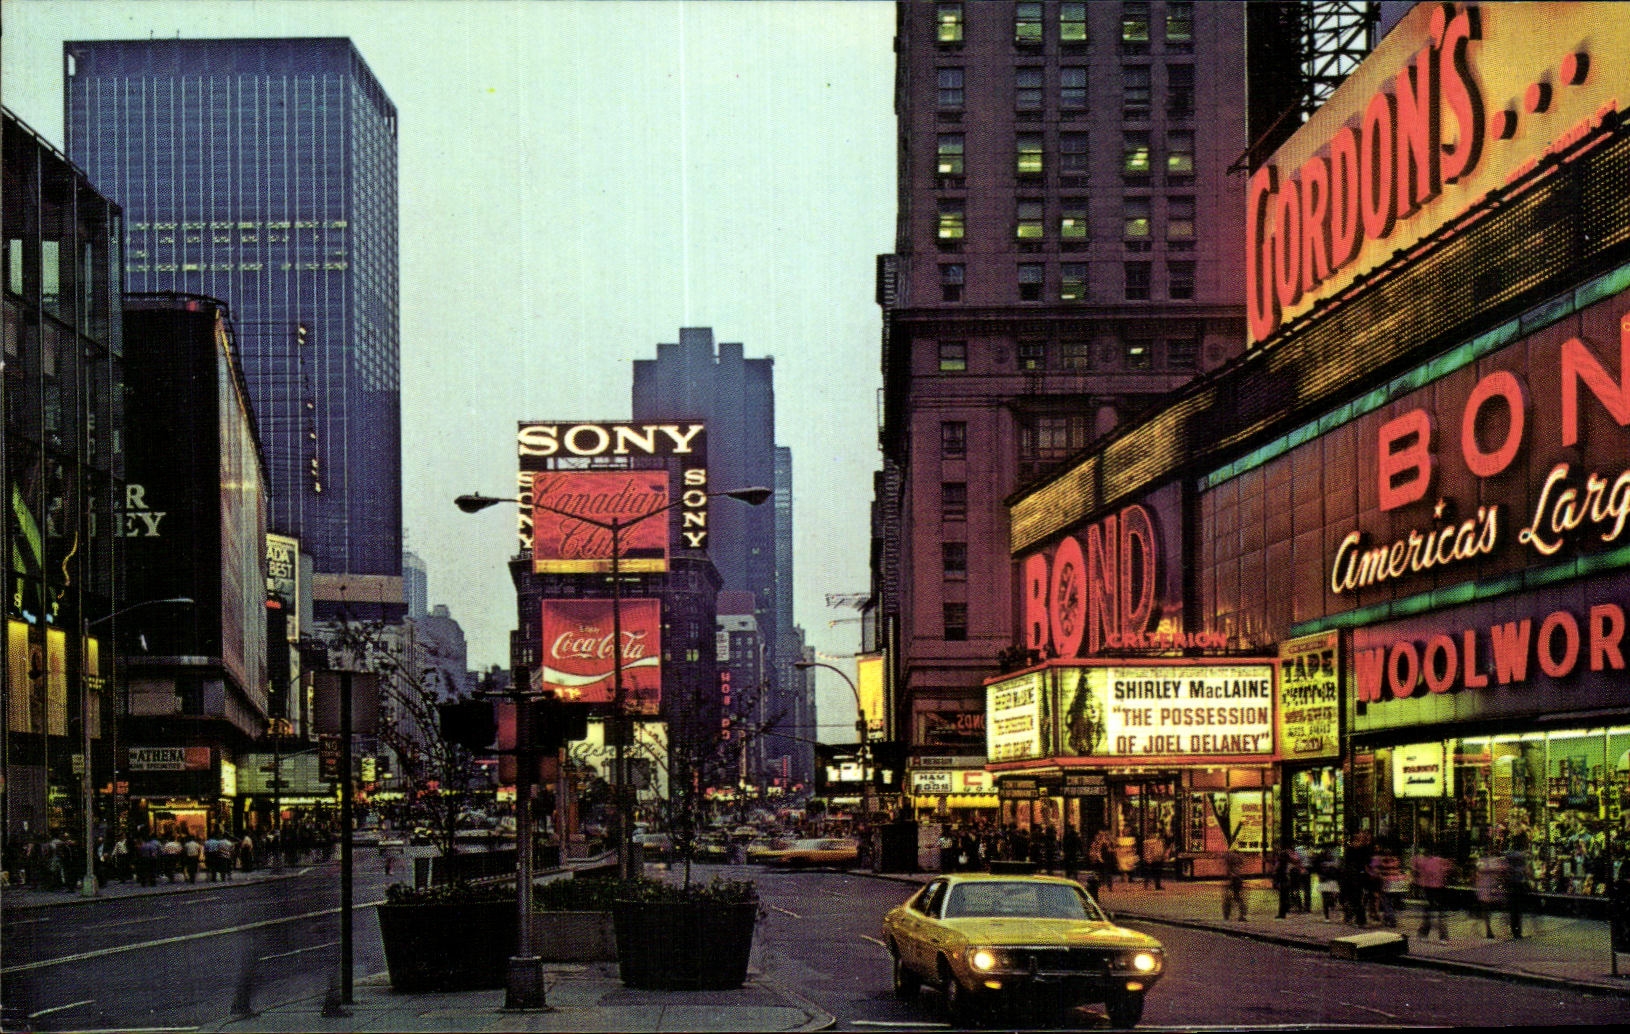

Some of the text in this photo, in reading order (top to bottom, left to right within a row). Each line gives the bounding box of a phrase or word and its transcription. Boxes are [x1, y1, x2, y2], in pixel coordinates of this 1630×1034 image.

[518, 425, 703, 456] SONY
[534, 473, 667, 519] Canadian
[683, 469, 706, 547] SONY
[1026, 504, 1156, 660] BOND
[551, 630, 649, 660] Coca-Cola
[1107, 632, 1228, 650] CRITERION
[1114, 680, 1269, 699] SHIRLEY MacLAINE
[1160, 706, 1268, 726] POSSESSION
[136, 749, 185, 763] ATHENA
[1116, 735, 1136, 753] OF
[1143, 734, 1184, 753] JOEL
